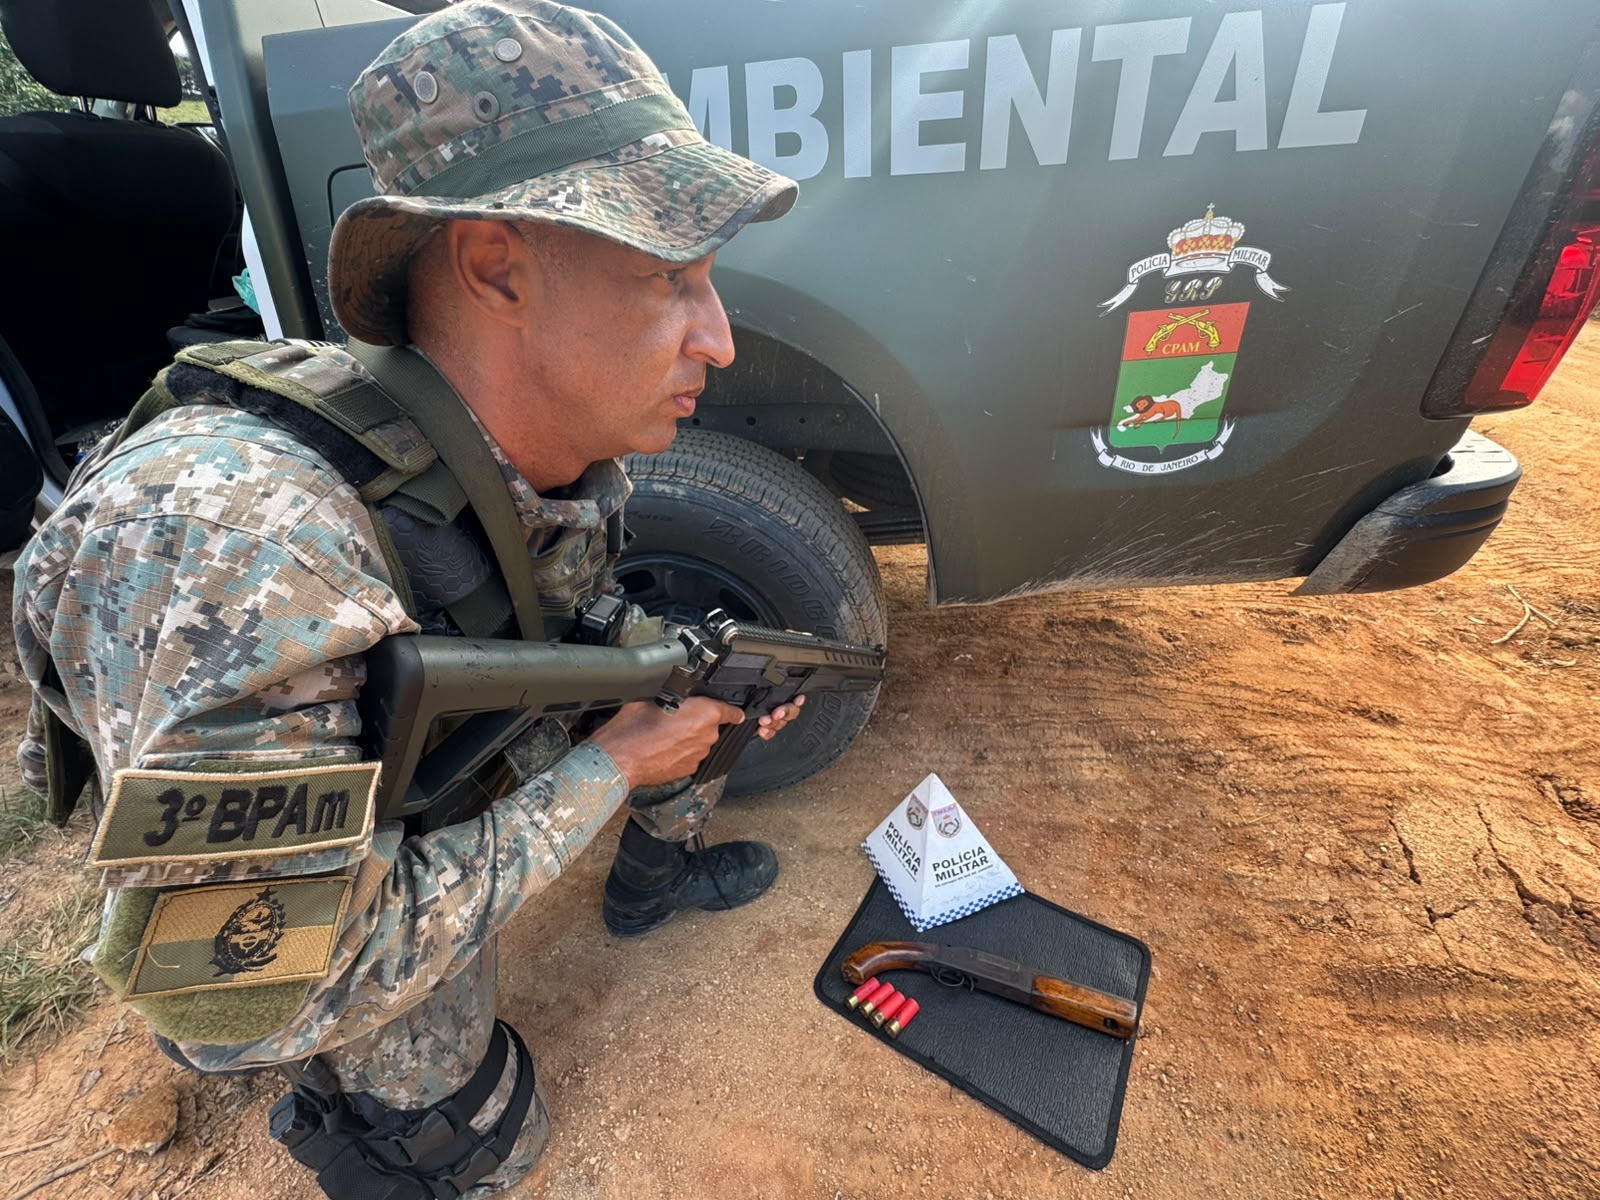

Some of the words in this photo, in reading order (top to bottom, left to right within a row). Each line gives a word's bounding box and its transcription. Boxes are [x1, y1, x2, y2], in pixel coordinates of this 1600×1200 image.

[661, 1, 1368, 182] MBIENTAL
[1232, 249, 1269, 271] MILITAR
[1162, 341, 1201, 355] CPAM
[1120, 459, 1136, 471] RIO
[1142, 464, 1155, 473] DE
[1160, 454, 1200, 472] JANEIRO
[206, 783, 350, 844] BPAm
[884, 829, 919, 876] MILITAR
[888, 821, 922, 868] POLÍCIA
[932, 846, 986, 872] POLÍCIA
[935, 855, 989, 882] MILITAR
